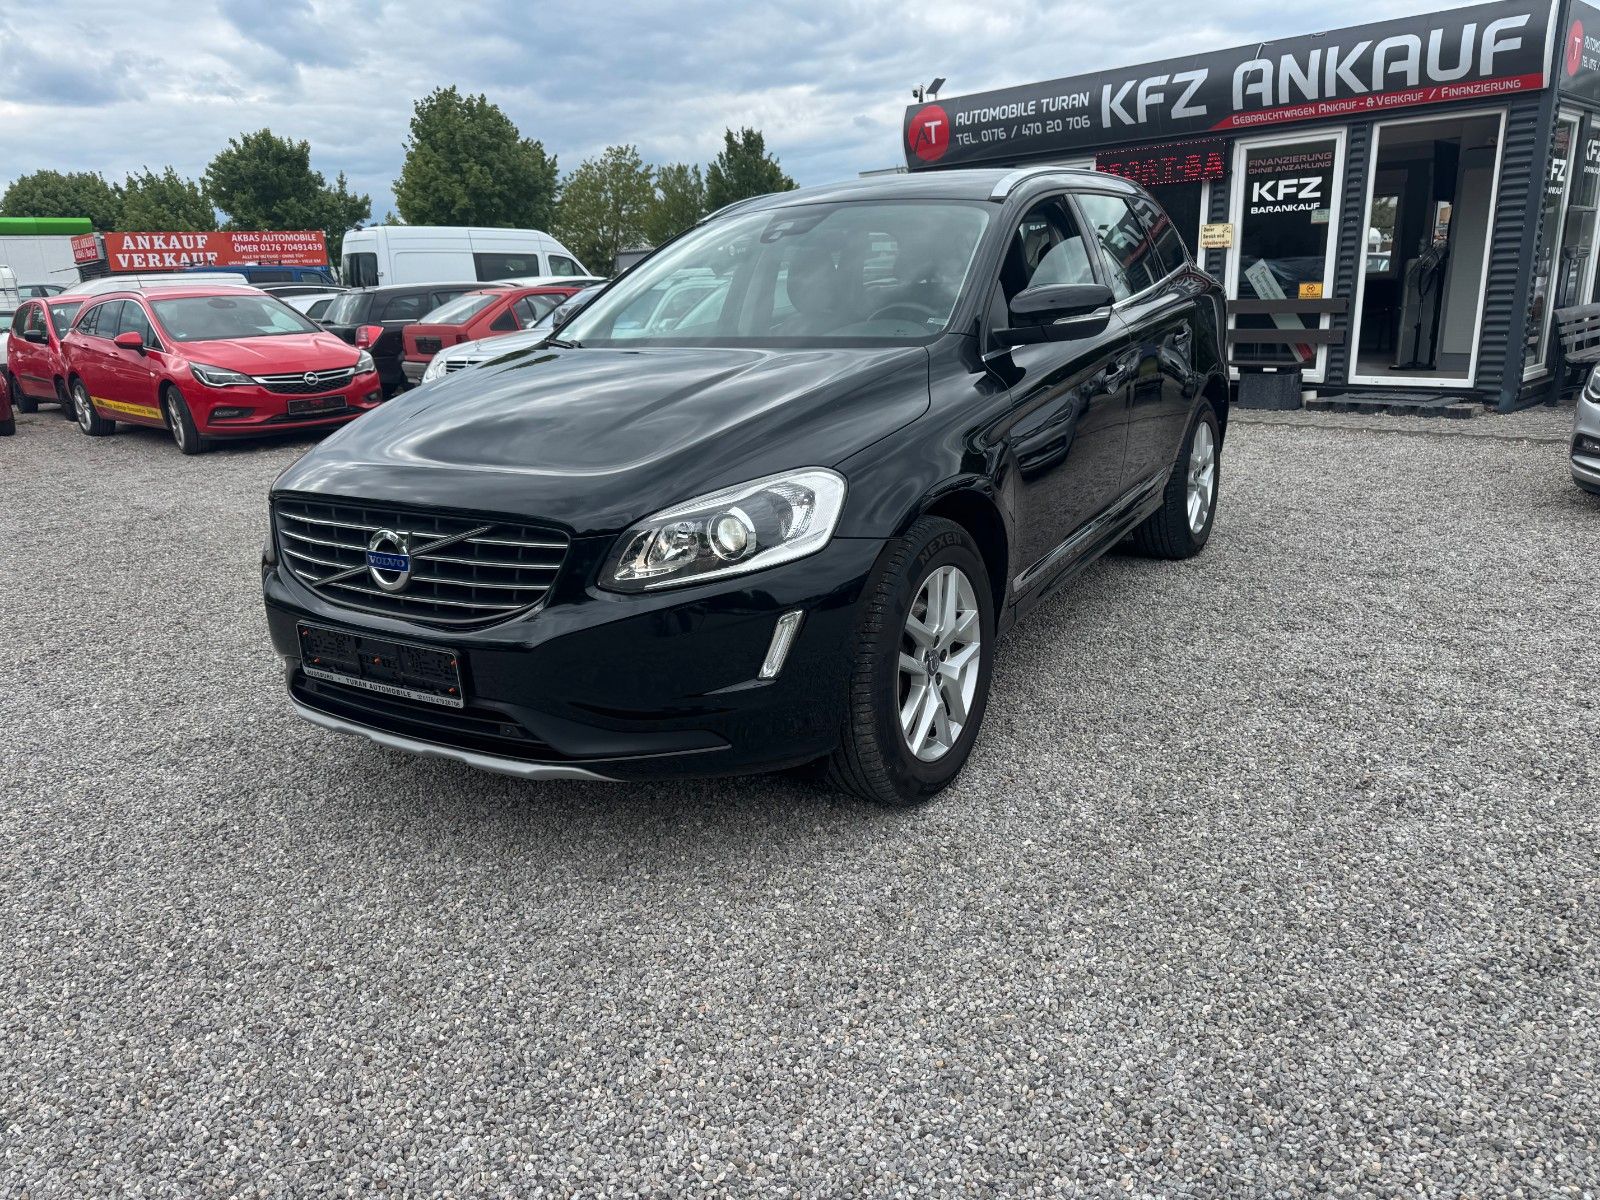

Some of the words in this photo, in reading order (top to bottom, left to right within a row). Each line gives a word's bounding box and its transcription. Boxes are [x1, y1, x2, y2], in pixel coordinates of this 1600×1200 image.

[1101, 68, 1208, 128] KFZ
[1232, 13, 1531, 110] ANKAUF
[955, 102, 1035, 126] AUTOMOBILE
[1041, 91, 1090, 111] TURAN
[956, 132, 978, 146] TEL.
[981, 128, 1006, 142] 0176
[1022, 122, 1042, 137] 470
[1046, 119, 1062, 133] 20
[1066, 115, 1090, 131] 706
[1249, 152, 1332, 167] FINANZIERUNG
[1275, 161, 1332, 172] ANZAHLUNG
[1550, 158, 1567, 181] FZ
[1252, 176, 1323, 203] KFZ
[1250, 202, 1321, 214] BARANKAUF
[122, 235, 208, 250] ANKAUF
[231, 234, 260, 242] AKBAS
[262, 233, 316, 242] AUTOMOBILE
[234, 243, 259, 252] ÖMER
[260, 243, 281, 251] 0176
[283, 243, 322, 251] 70491439
[116, 252, 218, 268] VERKAUF
[368, 555, 405, 567] VOLVO
[345, 678, 367, 688] TURAN
[369, 683, 411, 697] AUTOMOBILE
